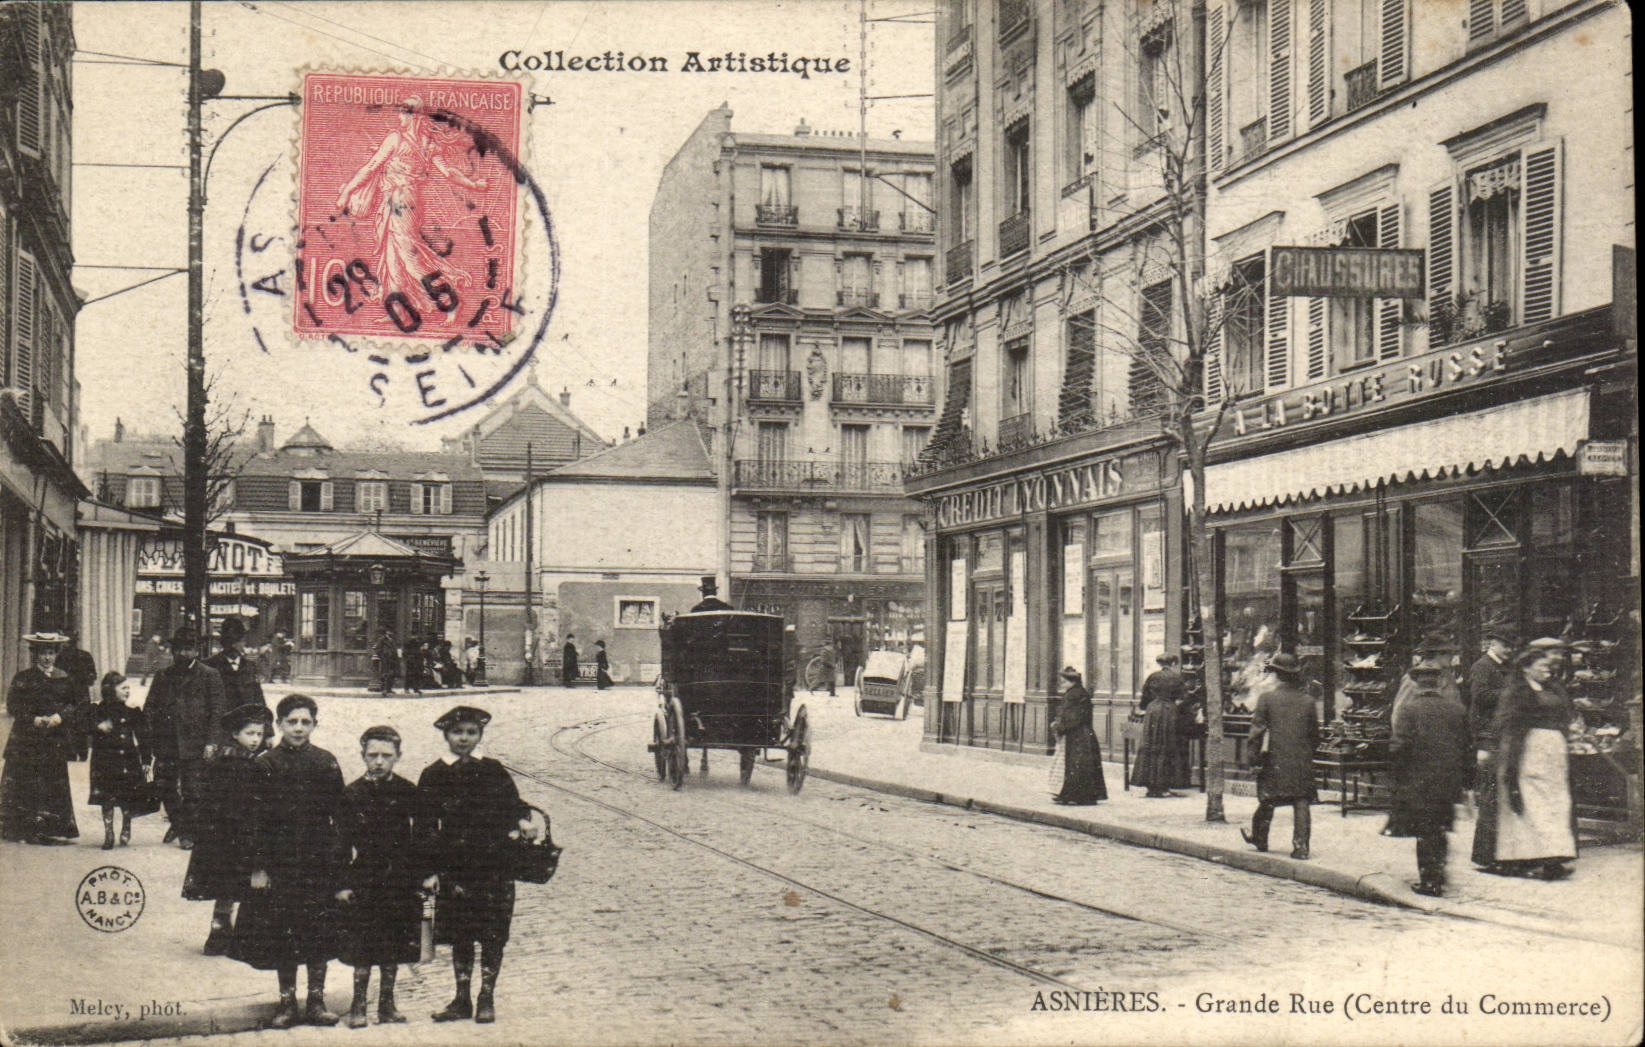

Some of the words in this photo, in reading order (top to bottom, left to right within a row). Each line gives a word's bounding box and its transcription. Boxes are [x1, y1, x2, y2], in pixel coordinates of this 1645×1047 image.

[1275, 251, 1420, 289] CHAUSSURES
[384, 269, 460, 334] 05
[1235, 409, 1246, 436] A
[1261, 399, 1288, 429] LA
[1408, 339, 1509, 394] RUSSE
[1013, 457, 1123, 515] LYONNAIS
